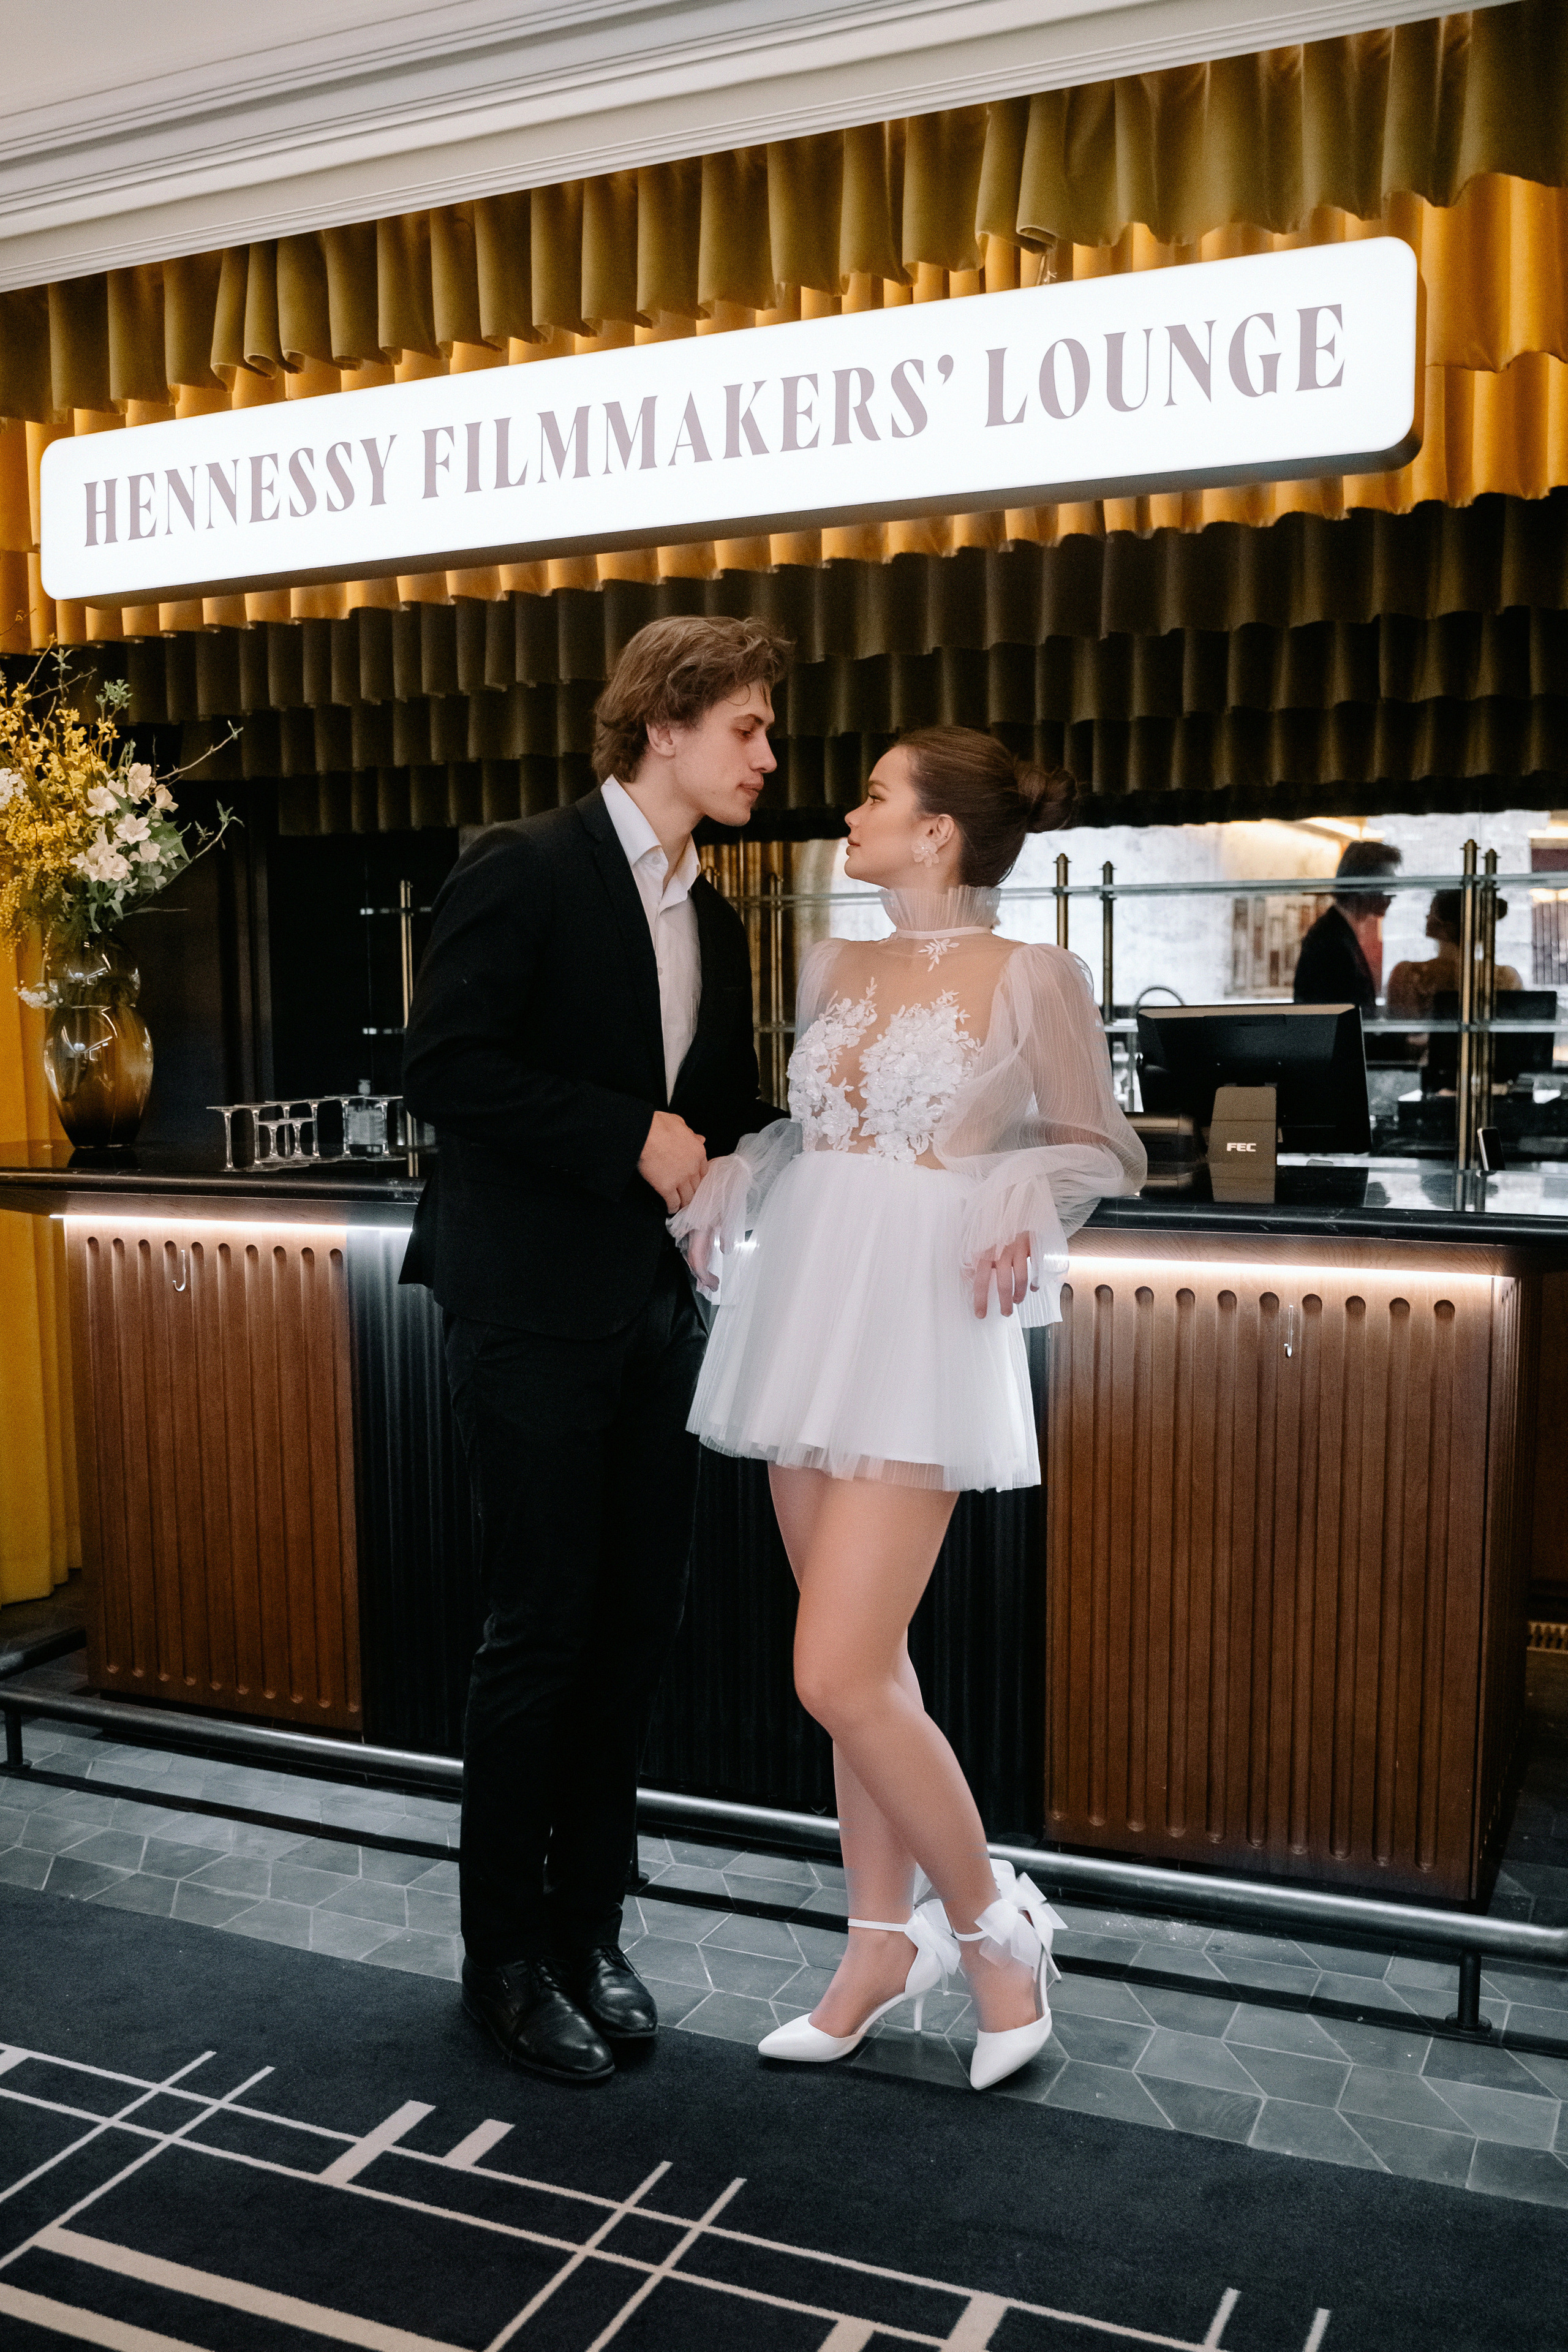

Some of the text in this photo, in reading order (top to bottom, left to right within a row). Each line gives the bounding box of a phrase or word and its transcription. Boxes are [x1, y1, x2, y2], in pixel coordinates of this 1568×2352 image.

[83, 304, 1344, 547] HENNESSY FILMMAKERS’ LOUNGE
[1227, 1142, 1256, 1152] FEC
